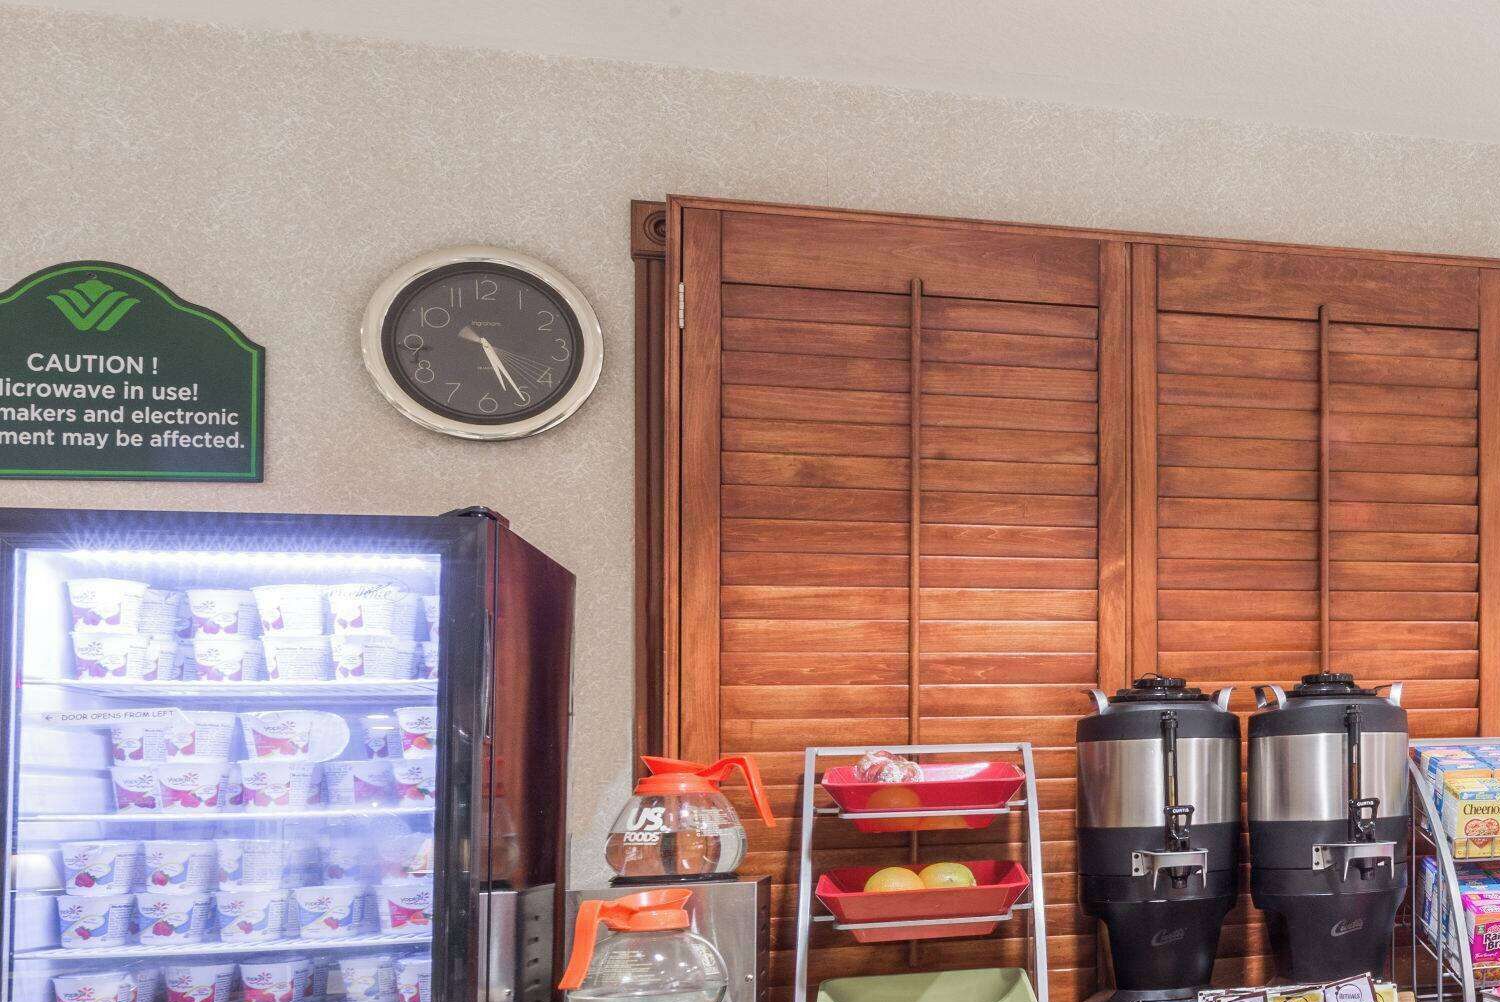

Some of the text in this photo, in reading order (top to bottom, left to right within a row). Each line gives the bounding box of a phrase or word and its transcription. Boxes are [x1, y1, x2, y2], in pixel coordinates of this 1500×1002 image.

[450, 287, 462, 308] 11
[475, 279, 498, 300] 12
[420, 306, 450, 328] 10
[537, 310, 554, 331] 2
[403, 334, 424, 356] 9
[551, 338, 570, 362] 3
[27, 352, 144, 374] CAUTION
[414, 359, 435, 384] 8
[537, 366, 552, 388] 4
[0, 377, 198, 401] icrowave in use!
[445, 382, 461, 403] 7
[513, 385, 531, 407] 5
[478, 392, 499, 413] 6
[83, 406, 124, 424] and
[131, 406, 239, 426] electronic
[62, 431, 109, 450] may
[116, 429, 144, 448] be
[149, 431, 245, 449] affected.
[61, 710, 174, 721] DOOR OPENS FROM LEFT
[624, 831, 660, 842] FOODS
[1338, 991, 1361, 1000] RITUALS
